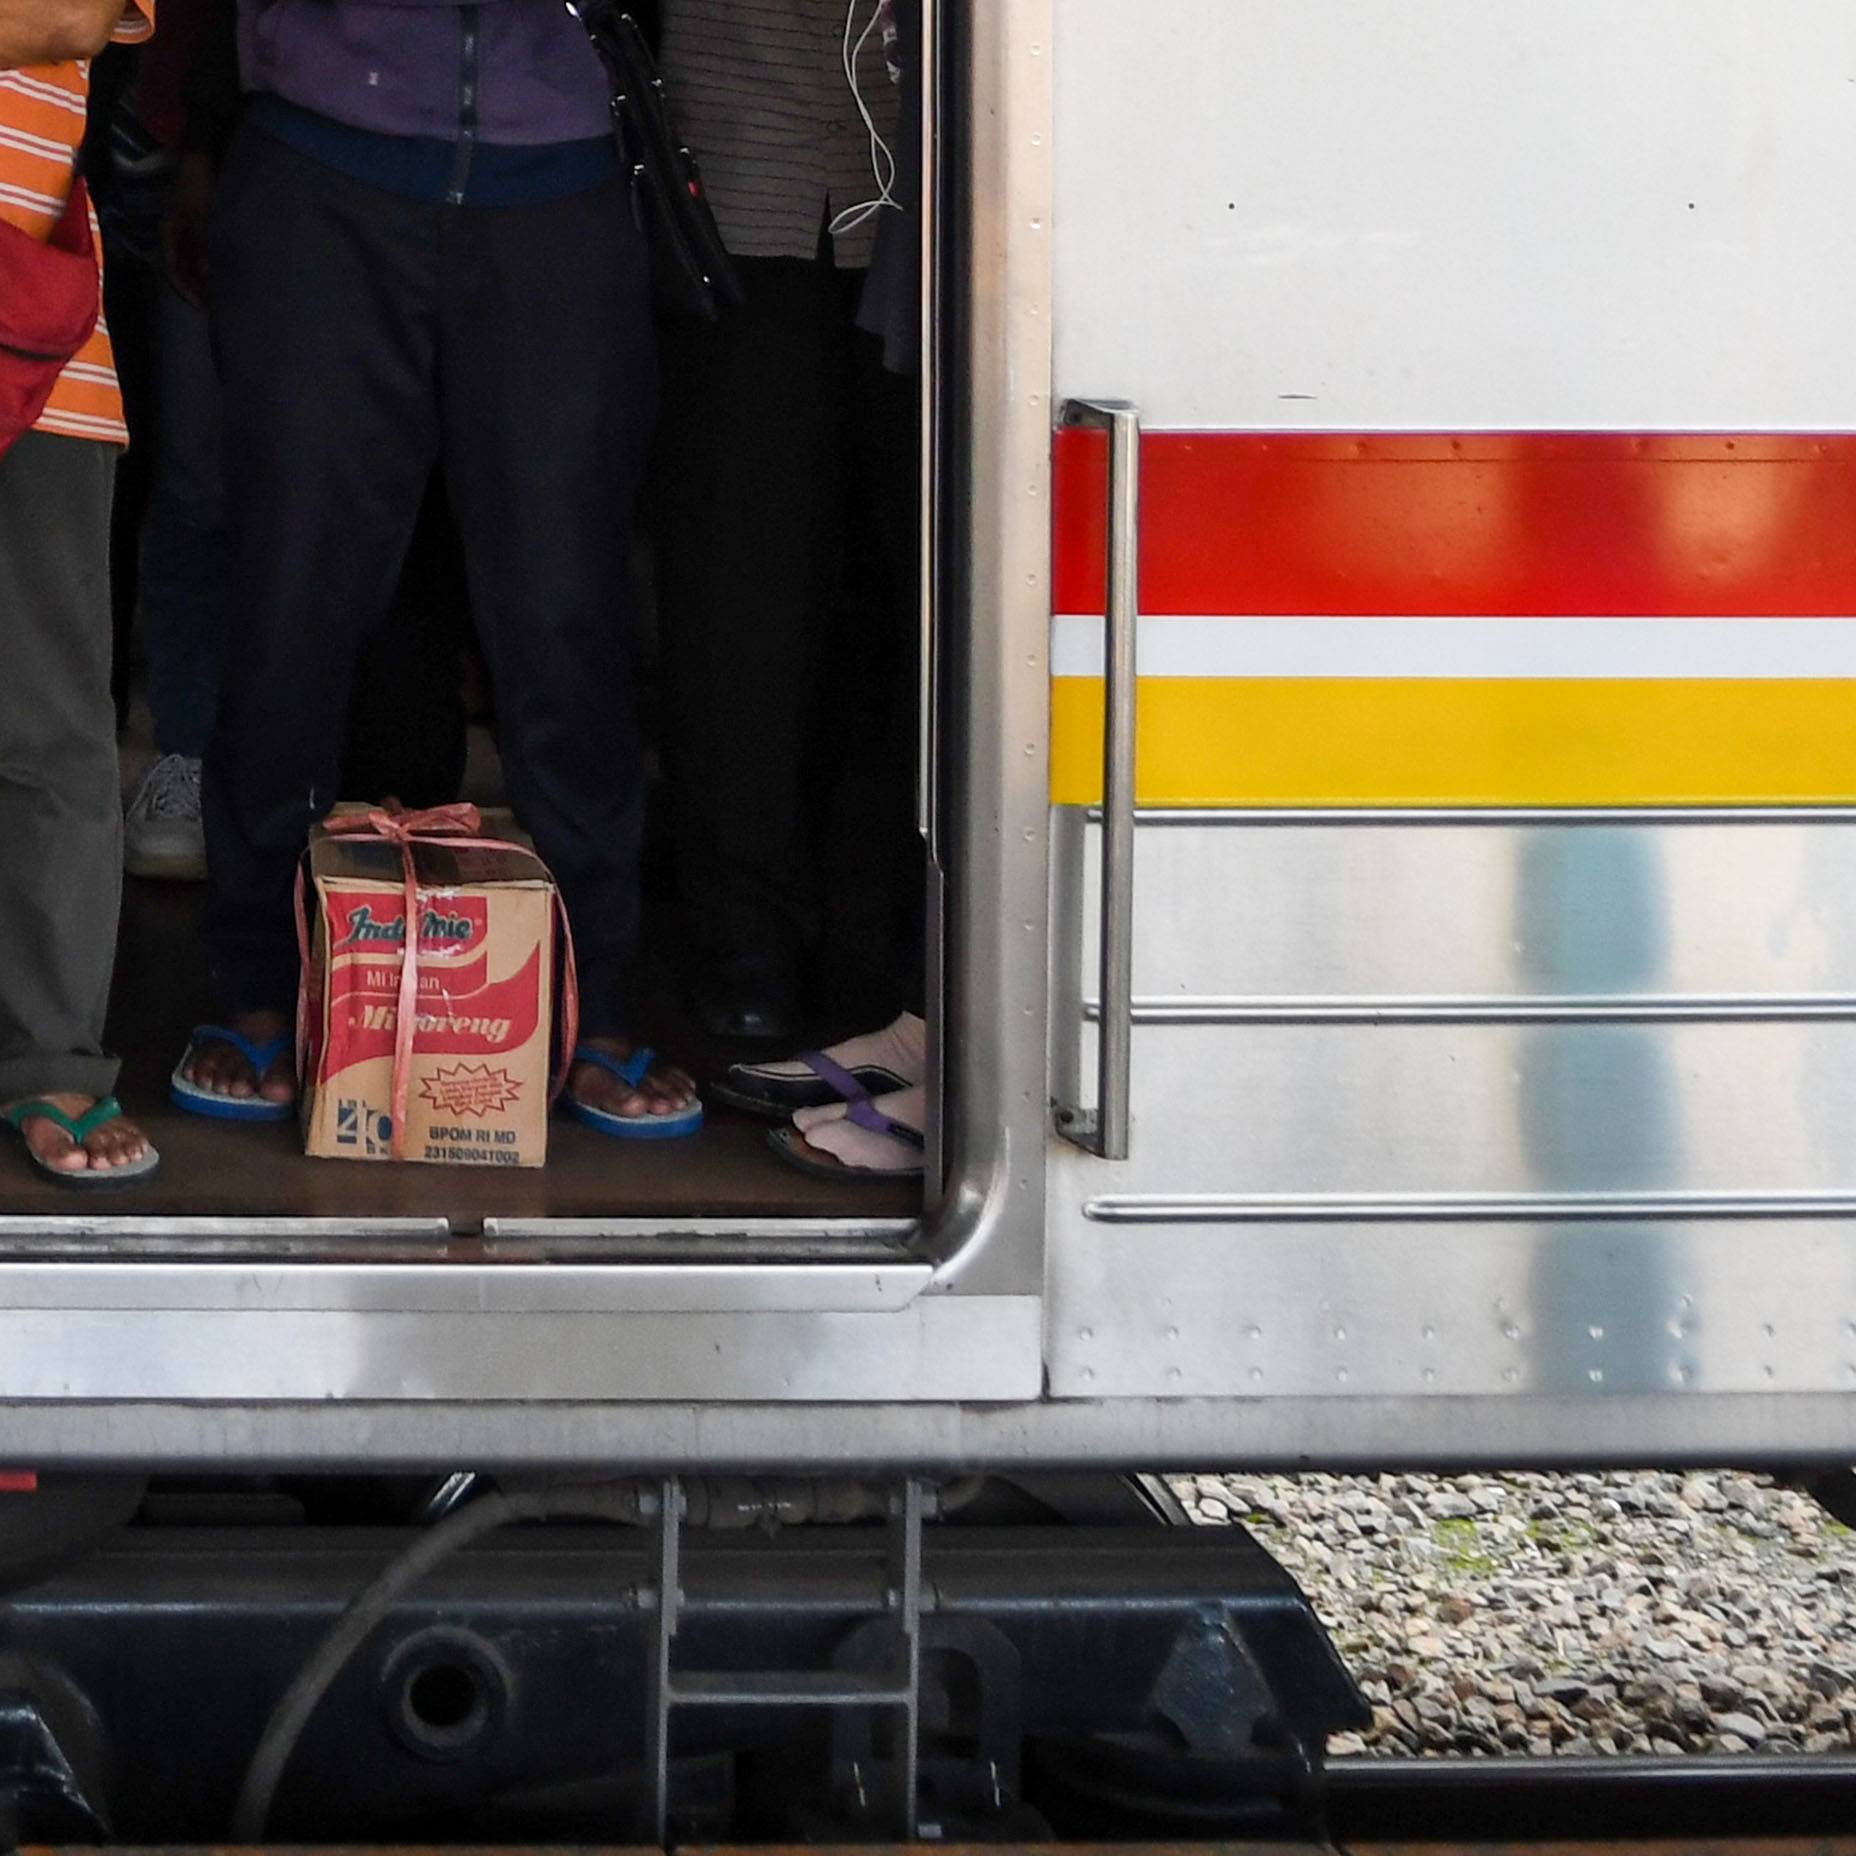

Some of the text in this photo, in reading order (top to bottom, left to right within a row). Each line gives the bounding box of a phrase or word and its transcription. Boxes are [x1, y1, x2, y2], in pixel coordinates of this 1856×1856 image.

[347, 905, 473, 940] Indmie
[414, 1011, 512, 1044] oreng
[494, 1129, 516, 1144] MD
